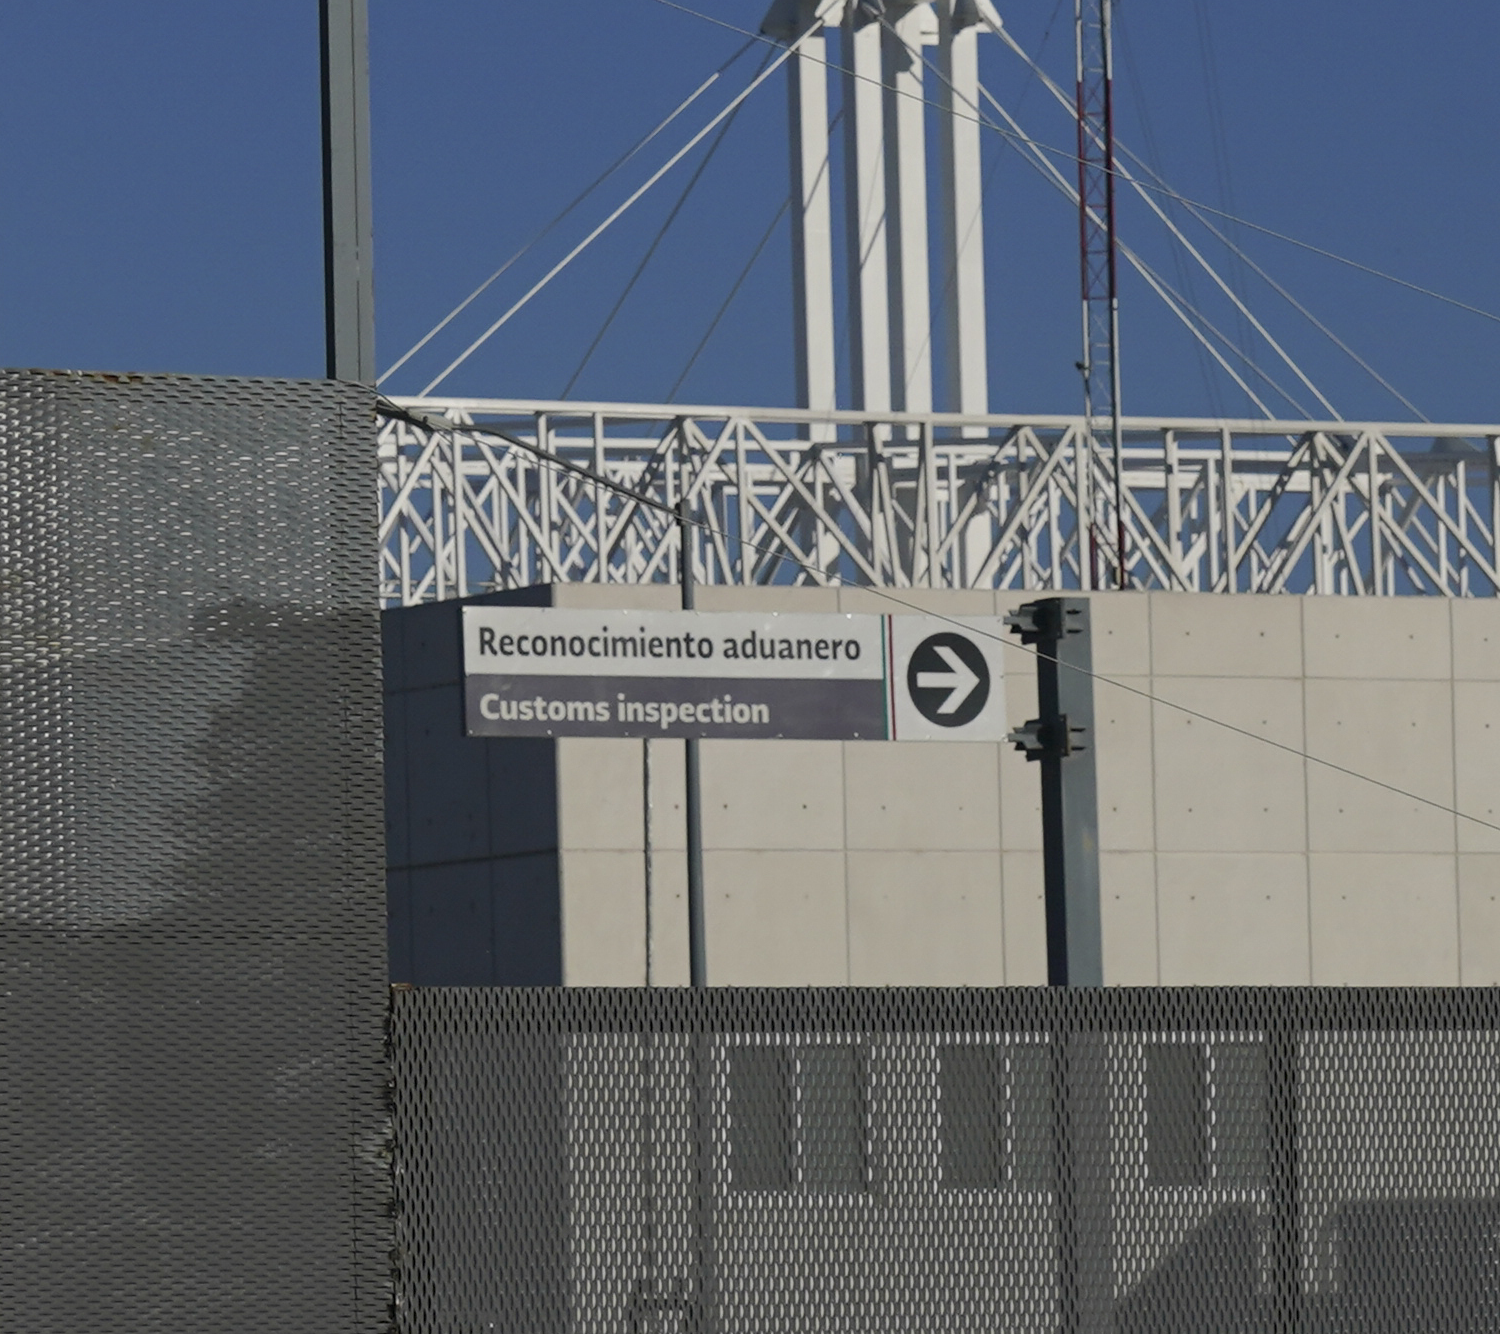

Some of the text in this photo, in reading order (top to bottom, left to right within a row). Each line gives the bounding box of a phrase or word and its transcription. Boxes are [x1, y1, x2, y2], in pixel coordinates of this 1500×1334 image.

[478, 626, 862, 661] Reconocimiento aduanero
[479, 693, 771, 729] Customs inspection
